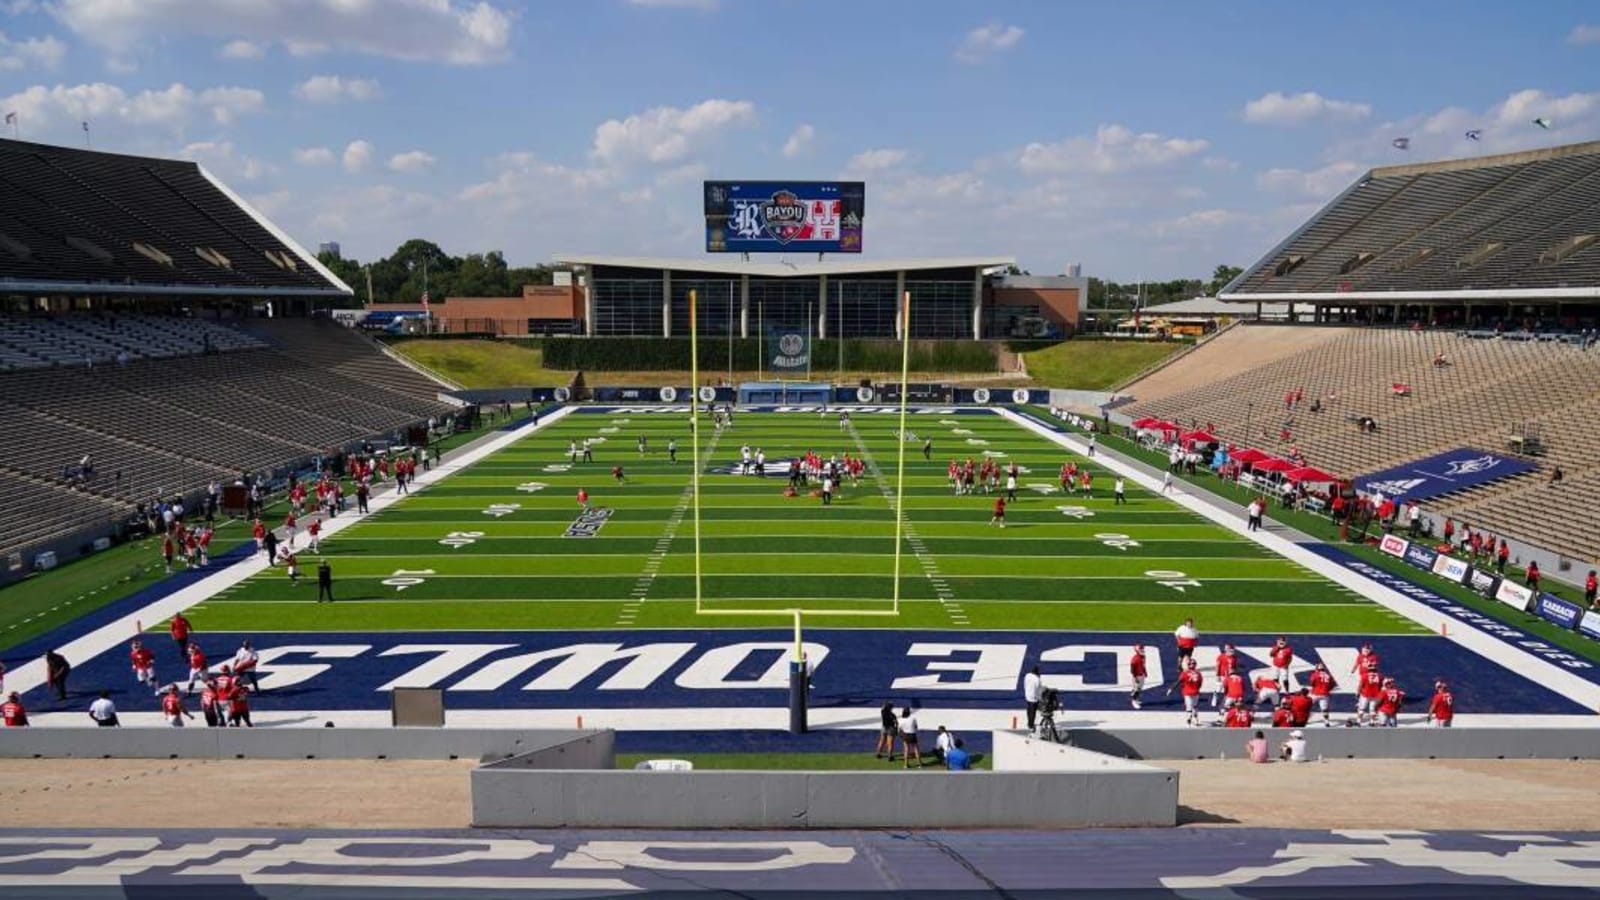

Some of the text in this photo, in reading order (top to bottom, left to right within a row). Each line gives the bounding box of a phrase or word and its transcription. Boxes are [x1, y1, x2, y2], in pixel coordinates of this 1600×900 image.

[766, 206, 803, 219] BAYOU
[1440, 606, 1526, 638] NEVER
[1518, 640, 1594, 668] DIES
[157, 643, 1359, 692] RICE OWLS
